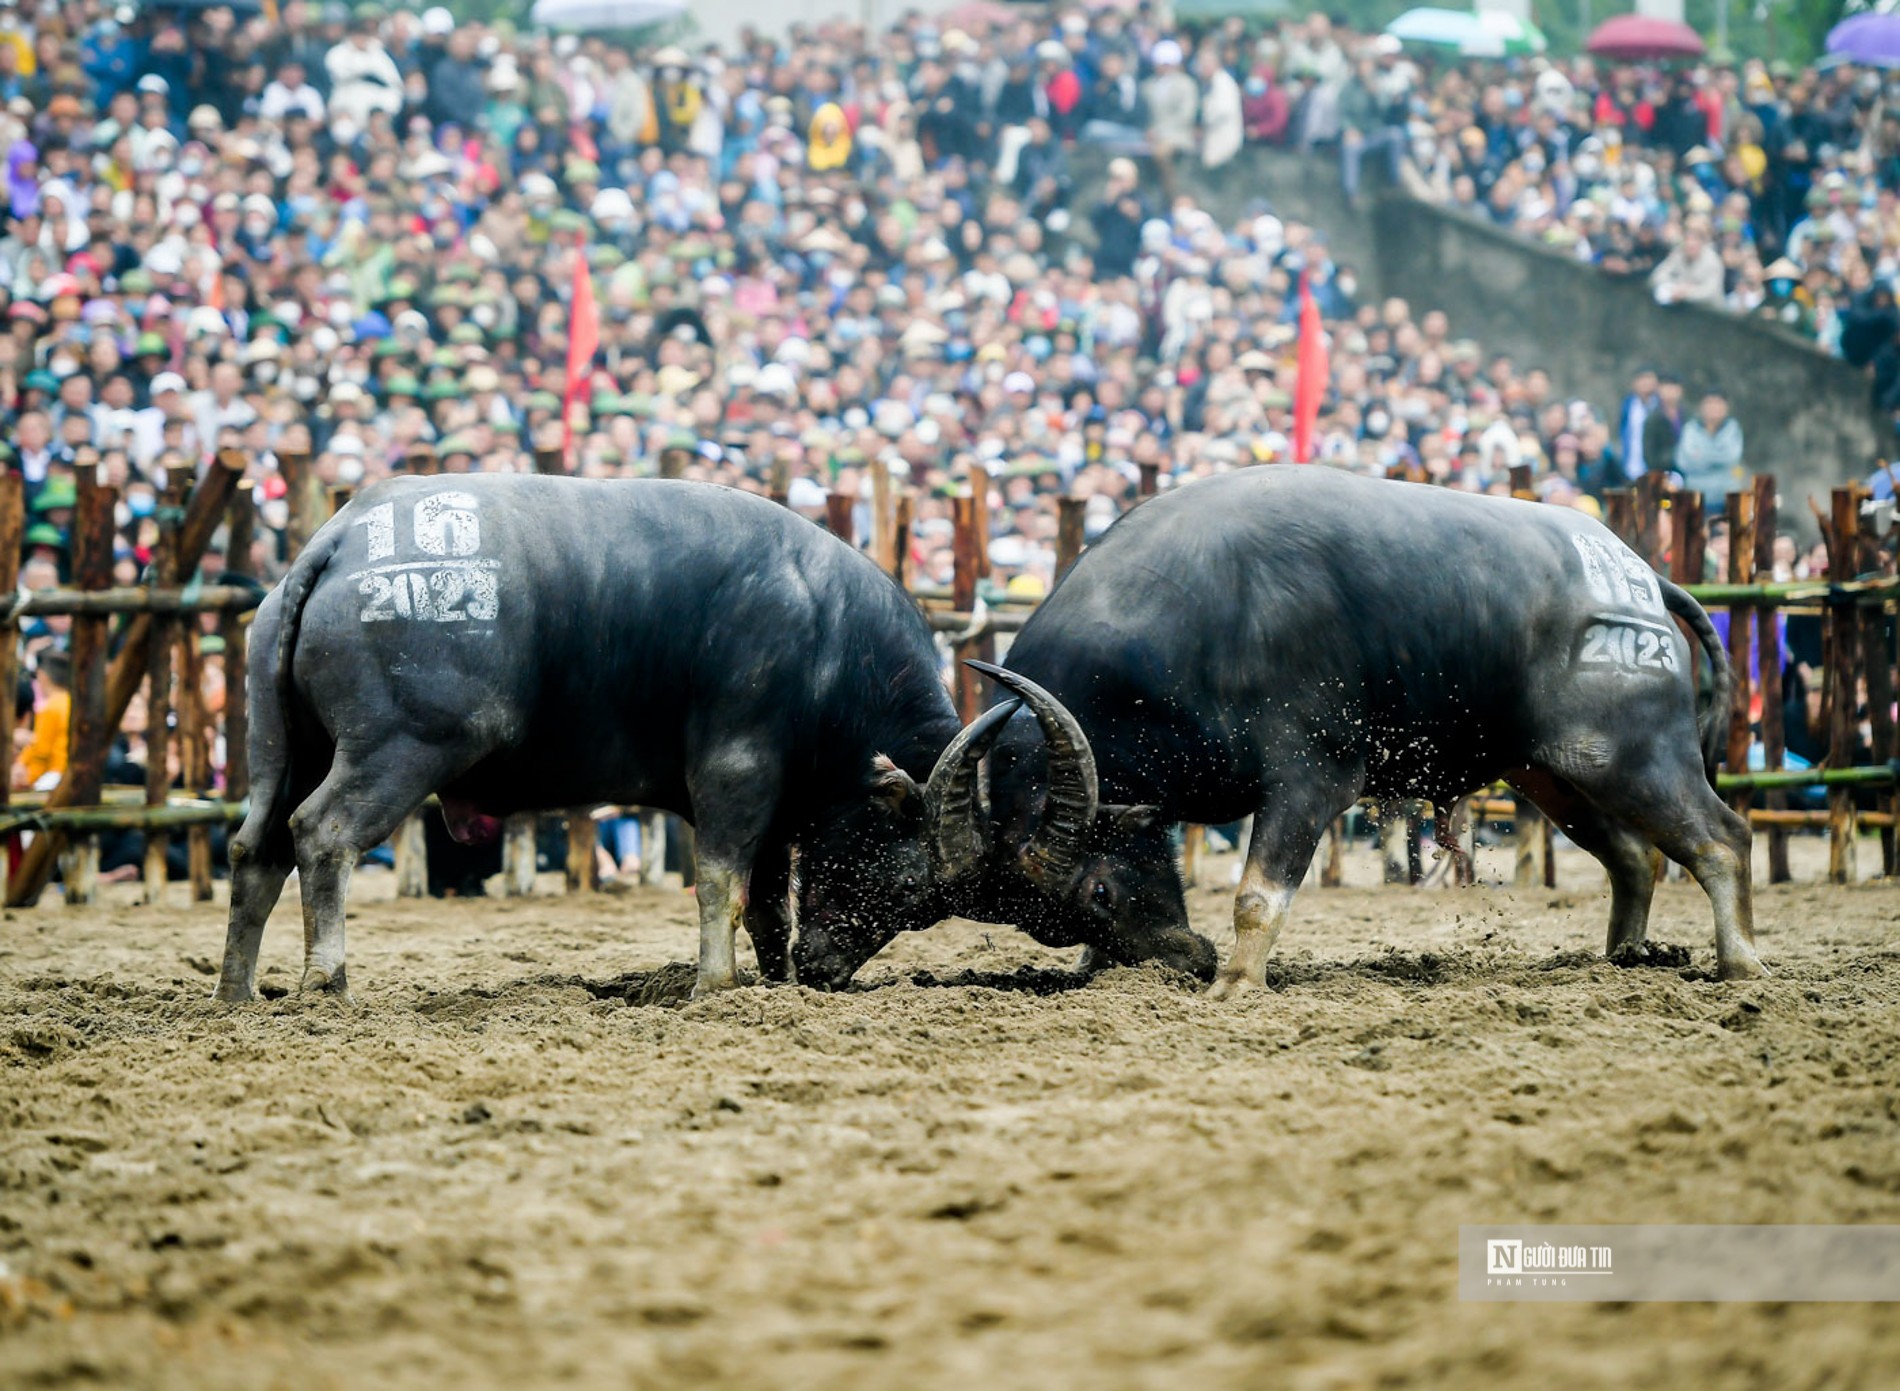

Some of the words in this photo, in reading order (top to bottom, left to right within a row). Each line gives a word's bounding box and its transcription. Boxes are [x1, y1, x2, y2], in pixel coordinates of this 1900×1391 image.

[353, 491, 481, 562] 16
[358, 569, 500, 622] 2023
[1579, 624, 1680, 672] 2023
